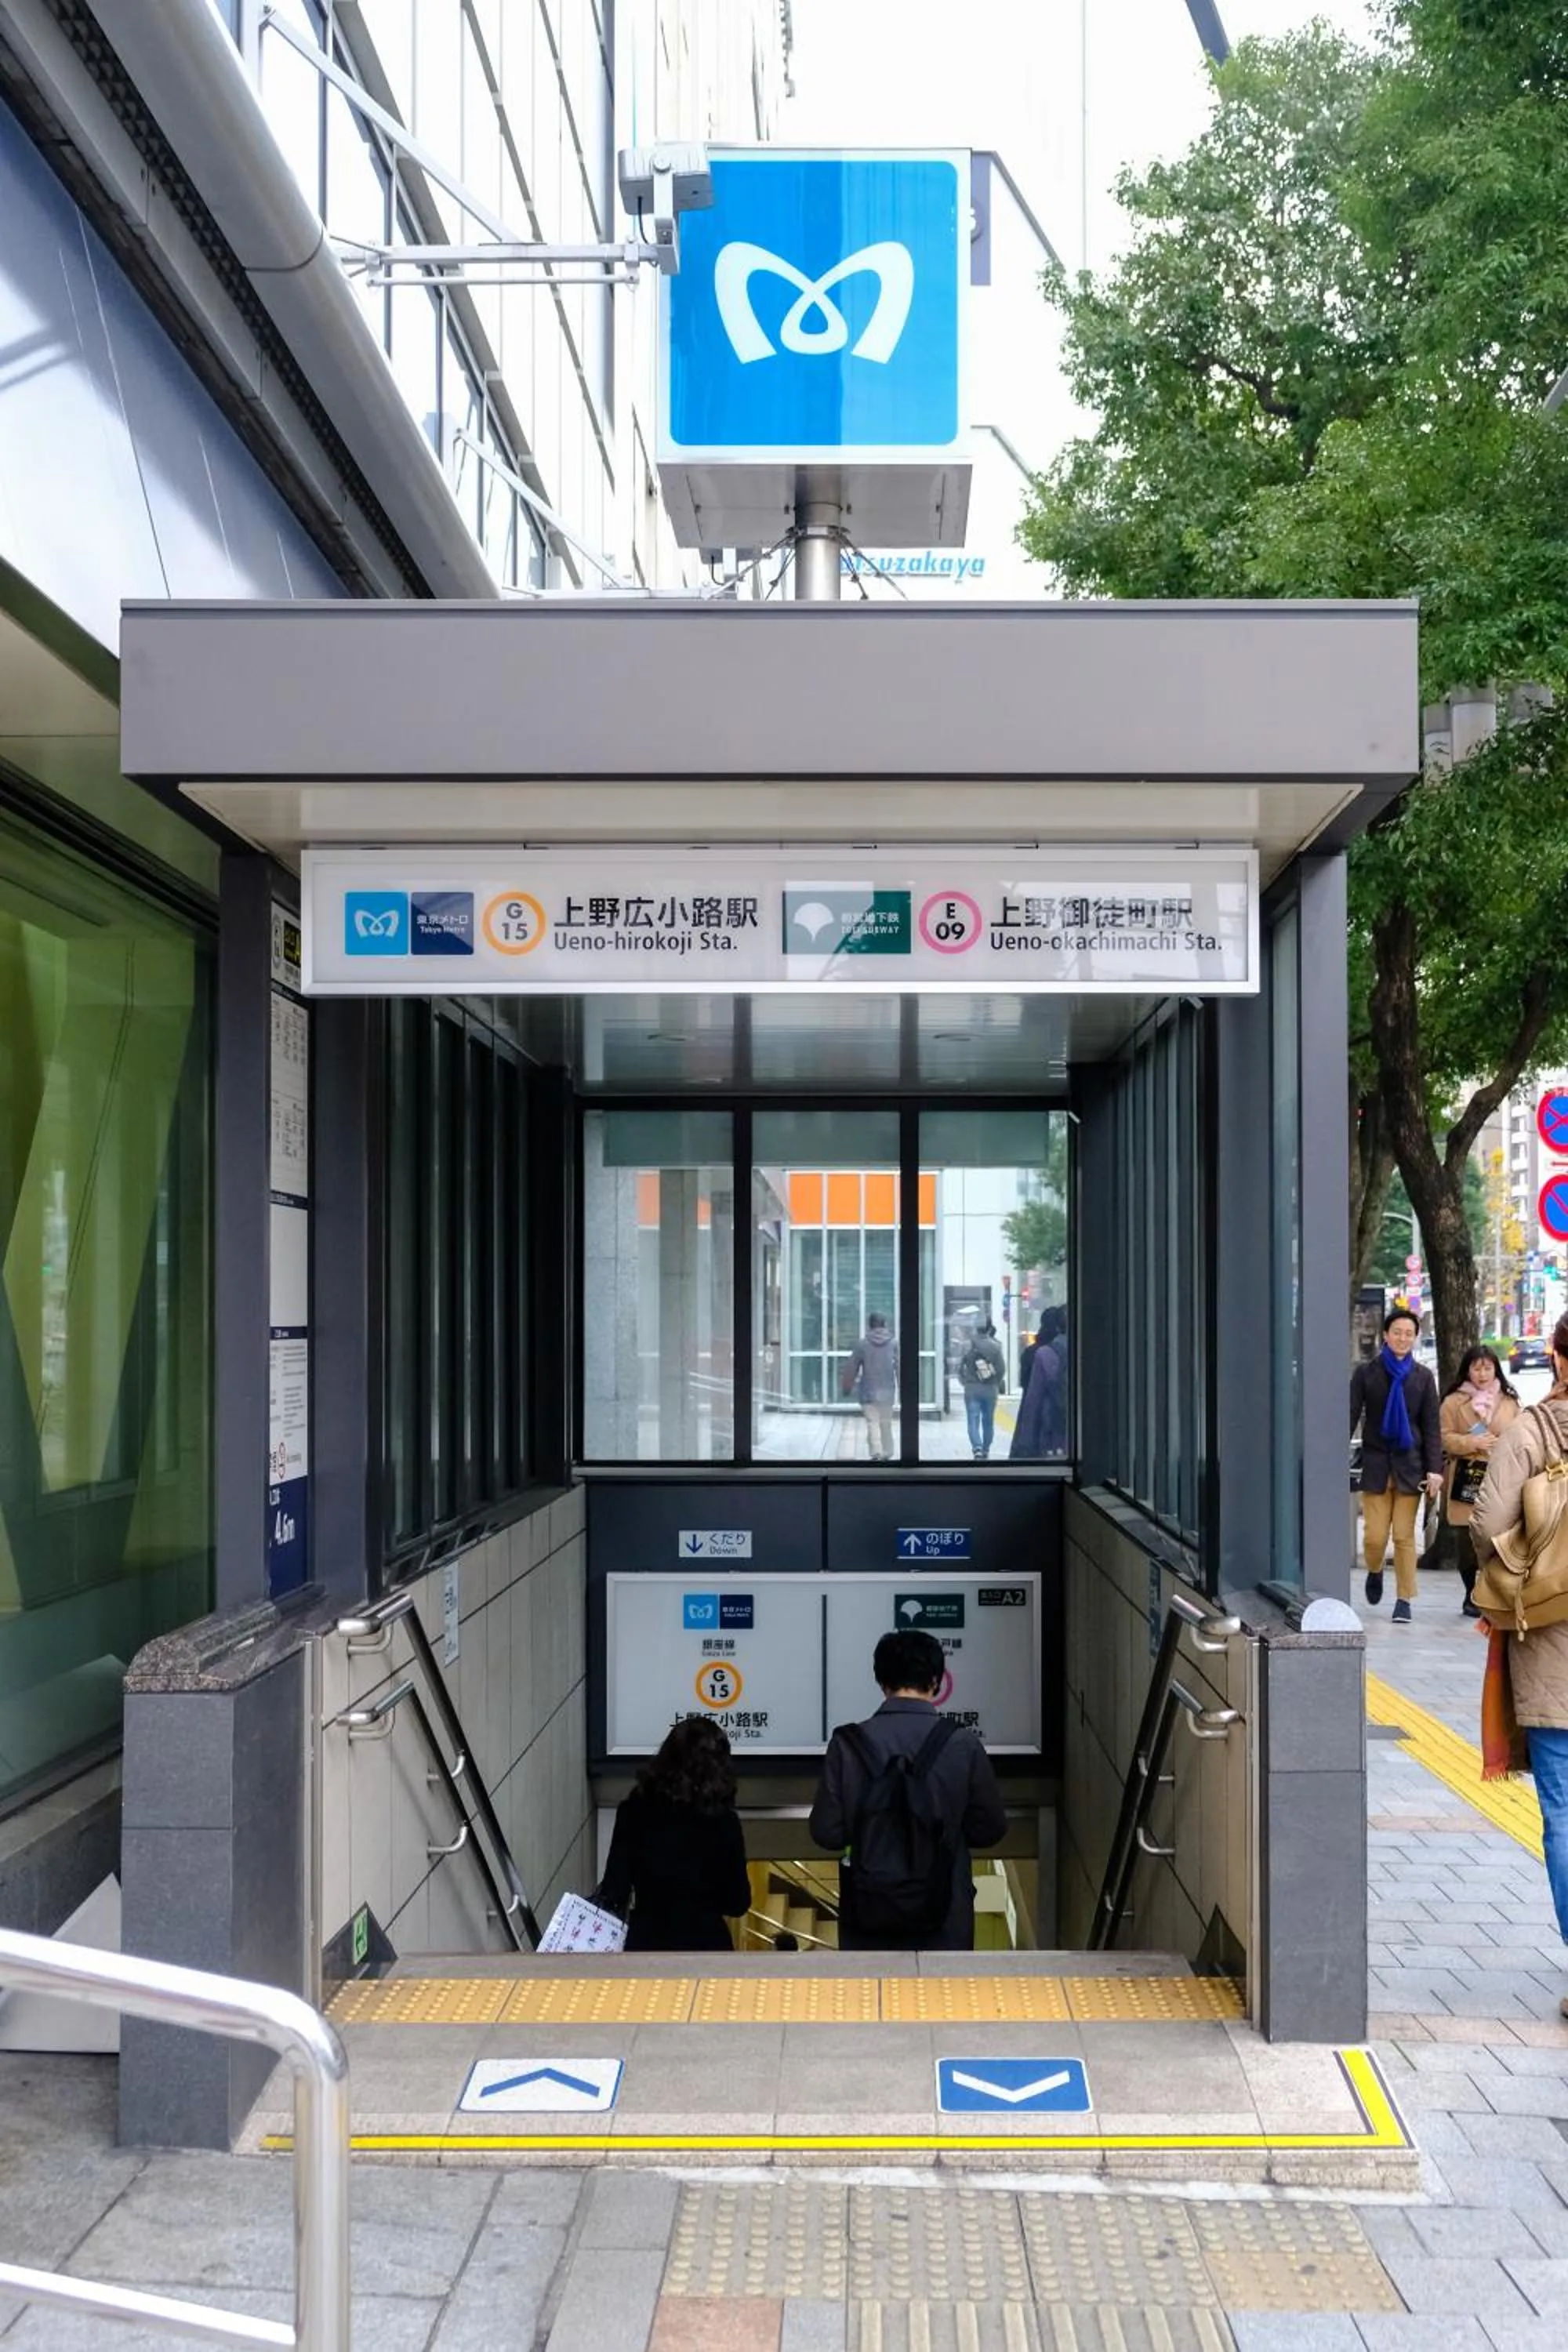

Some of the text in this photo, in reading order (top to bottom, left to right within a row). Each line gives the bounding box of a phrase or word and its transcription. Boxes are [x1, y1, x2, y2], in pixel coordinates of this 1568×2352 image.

[506, 902, 523, 920] G
[554, 896, 758, 928] 上野広小路駅
[946, 902, 956, 919] E
[990, 897, 1192, 928] 上野御徒町駅
[417, 915, 468, 924] 東京メトロ
[420, 925, 441, 934] Tokyo
[501, 922, 528, 940] 15
[935, 922, 965, 940] 09
[554, 931, 738, 955] Ueno-hirokoji Sta.
[990, 931, 1222, 950] Ueno-okachimachi Sta.
[710, 1533, 746, 1545] くだり
[926, 1532, 964, 1544] のぼり
[710, 1546, 738, 1555] Down
[926, 1545, 940, 1555] Up
[1002, 1591, 1024, 1604] A2
[713, 1669, 725, 1682] G
[710, 1684, 729, 1697] 15
